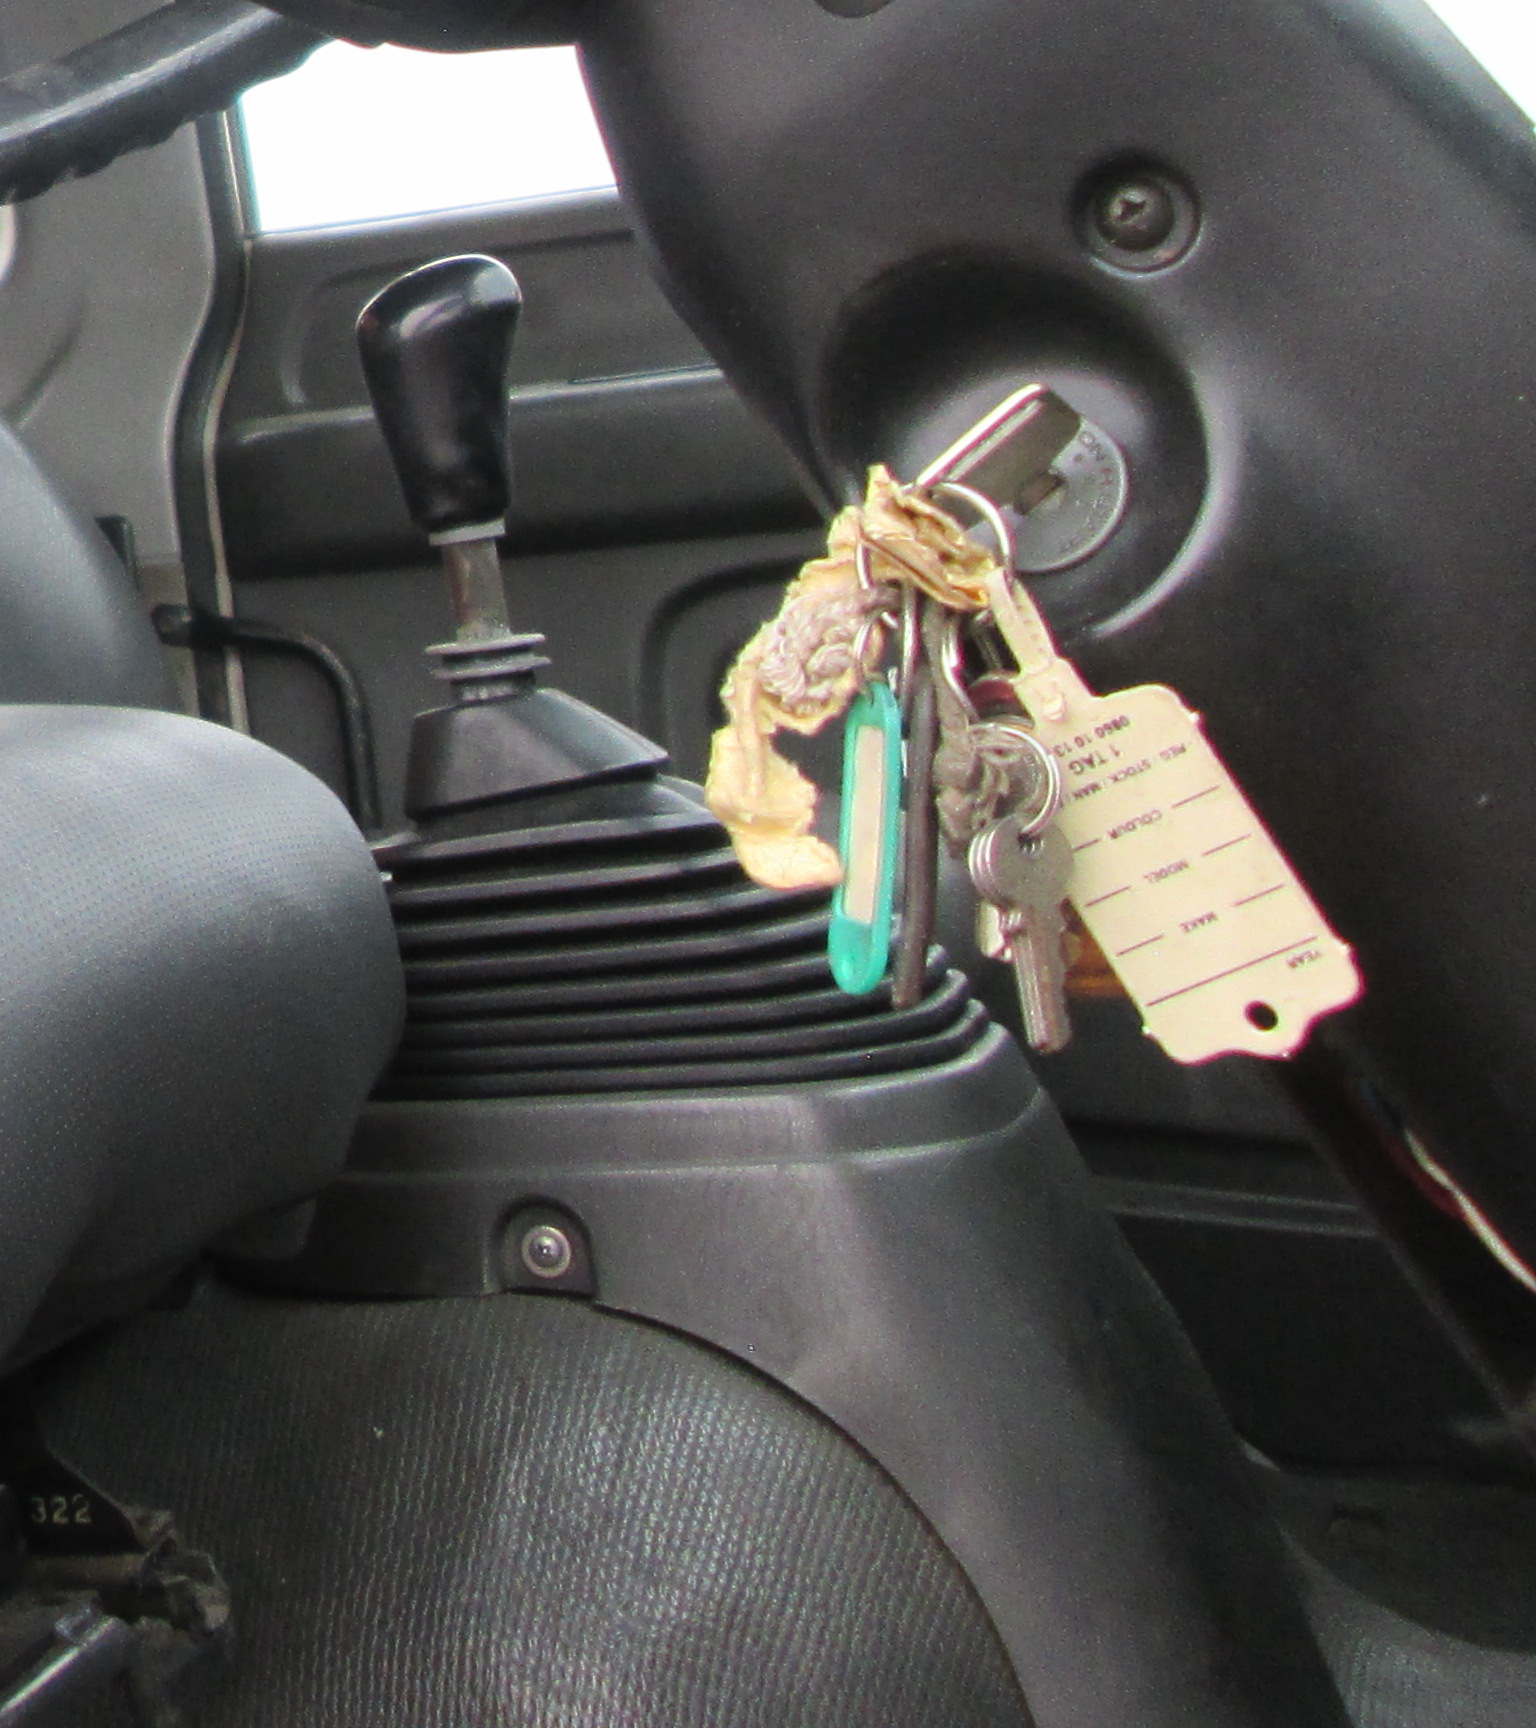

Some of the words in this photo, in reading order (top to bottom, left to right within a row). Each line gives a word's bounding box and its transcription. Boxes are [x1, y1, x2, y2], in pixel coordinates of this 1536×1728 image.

[1072, 731, 1092, 749] 10
[1108, 742, 1121, 758] 1
[1066, 747, 1109, 777] TAG
[1107, 757, 1151, 786] STOCK
[1071, 779, 1102, 802] MAN
[1106, 807, 1163, 841] COLOUR
[1142, 857, 1190, 887] MODEL
[1178, 908, 1219, 936] MAKE
[1285, 945, 1322, 972] YEAR
[31, 1494, 92, 1525] 322
